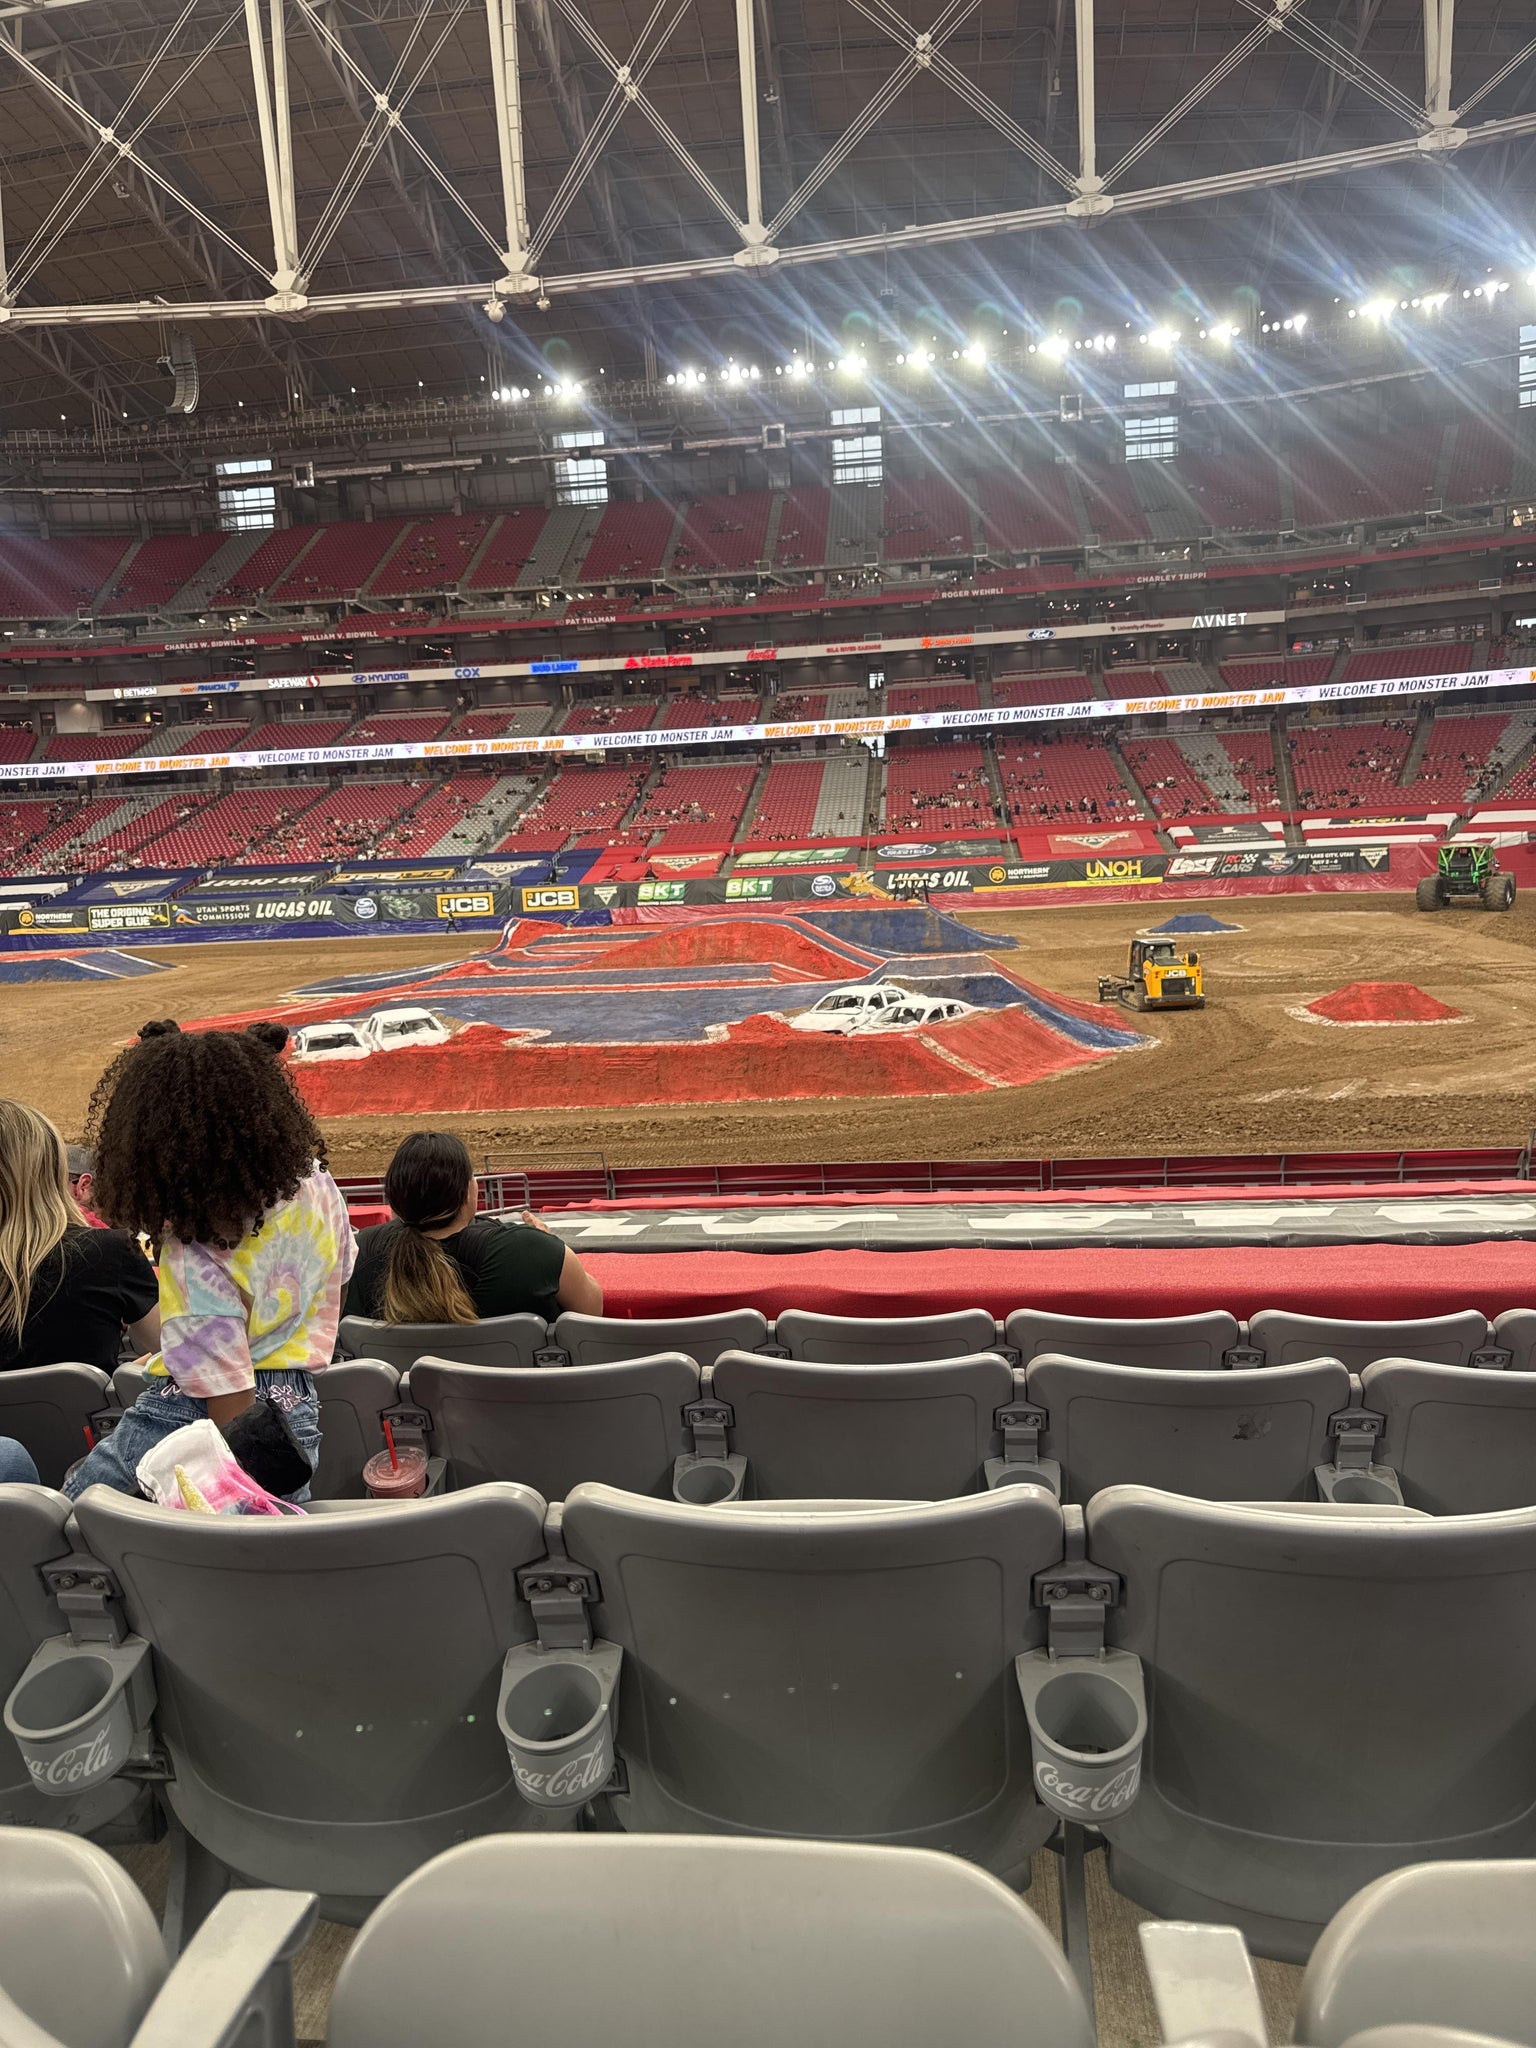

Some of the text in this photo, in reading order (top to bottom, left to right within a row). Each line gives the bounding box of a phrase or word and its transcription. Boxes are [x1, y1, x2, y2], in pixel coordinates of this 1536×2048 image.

[1137, 574, 1176, 584] CHARLEY
[1178, 572, 1207, 581] TRIPPI
[941, 590, 970, 599] ROGER
[971, 588, 1003, 597] WEHRLI
[565, 617, 580, 625] PAT
[582, 616, 616, 624] TILLMAN
[1192, 613, 1248, 628] AVNET
[301, 630, 379, 641] WILLIAM V. BIDWILL
[165, 643, 198, 651] CHARLES
[246, 638, 257, 646] SR.
[368, 672, 409, 681] HYUNDAI
[455, 667, 480, 679] COX
[268, 677, 307, 689] SAFEWAY
[1319, 675, 1489, 698] WELCOME TO MONSTER JAM
[123, 688, 157, 697] BETMGM
[1125, 691, 1285, 713] WELCOME TO MONSTER JAM
[942, 706, 1091, 724] WELCOME TO MONSTER JAM
[764, 718, 911, 737] WELCOME TO MONSTER JAM
[593, 729, 733, 747] WELCOME TO MONSTER JAM
[424, 739, 564, 756] WELCOME TO MONSTER JAM
[258, 748, 393, 763] WELCOME TO MONSTER JAM
[42, 765, 65, 776] JAM
[95, 757, 230, 774] WELCOME TO MONSTER JAM
[1225, 855, 1242, 863] RC
[1007, 867, 1050, 875] NORTHERN
[1086, 859, 1142, 877] UNOH
[1222, 863, 1253, 873] CARS
[943, 871, 969, 887] OIL
[726, 877, 774, 897] BKT
[442, 897, 489, 912] JCB
[527, 891, 574, 907] JCB
[91, 907, 154, 918] THE ORIGINAL
[196, 904, 250, 914] UTAH SPORTS
[255, 901, 306, 919] LUCAS
[91, 917, 150, 928] SUPER GLUE
[197, 912, 250, 921] COMMISSION
[24, 1722, 112, 1784] ca-Cola
